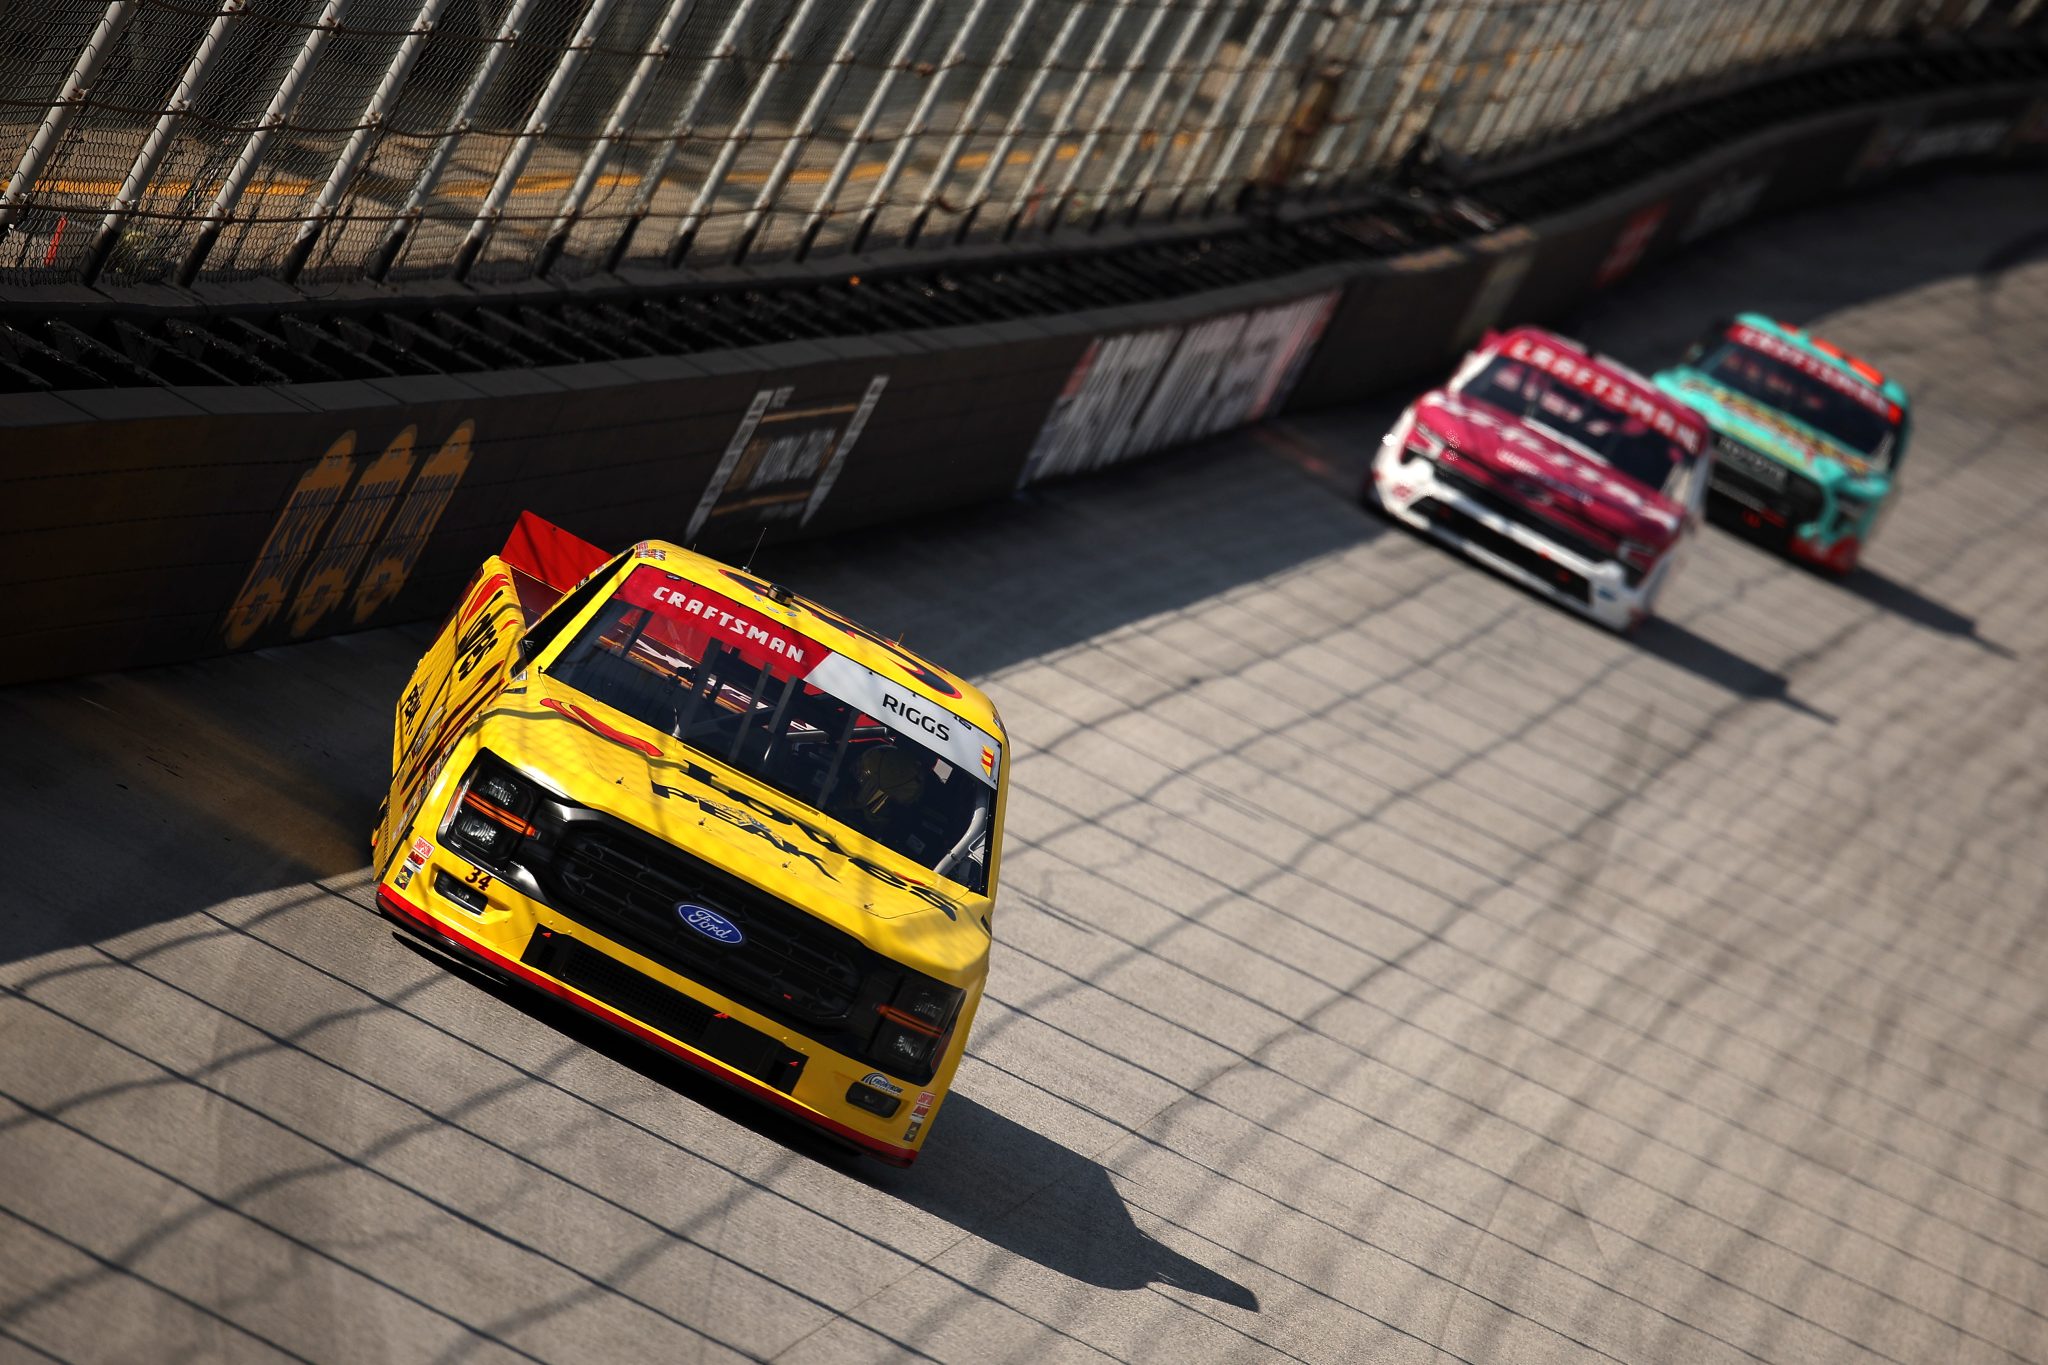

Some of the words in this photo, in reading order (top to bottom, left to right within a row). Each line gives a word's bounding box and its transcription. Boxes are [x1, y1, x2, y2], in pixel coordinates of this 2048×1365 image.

[653, 586, 804, 663] CRAFTSMAN
[882, 693, 950, 742] RIGGS
[651, 779, 841, 884] PEAK
[464, 866, 493, 891] 34
[688, 910, 732, 938] Ford
